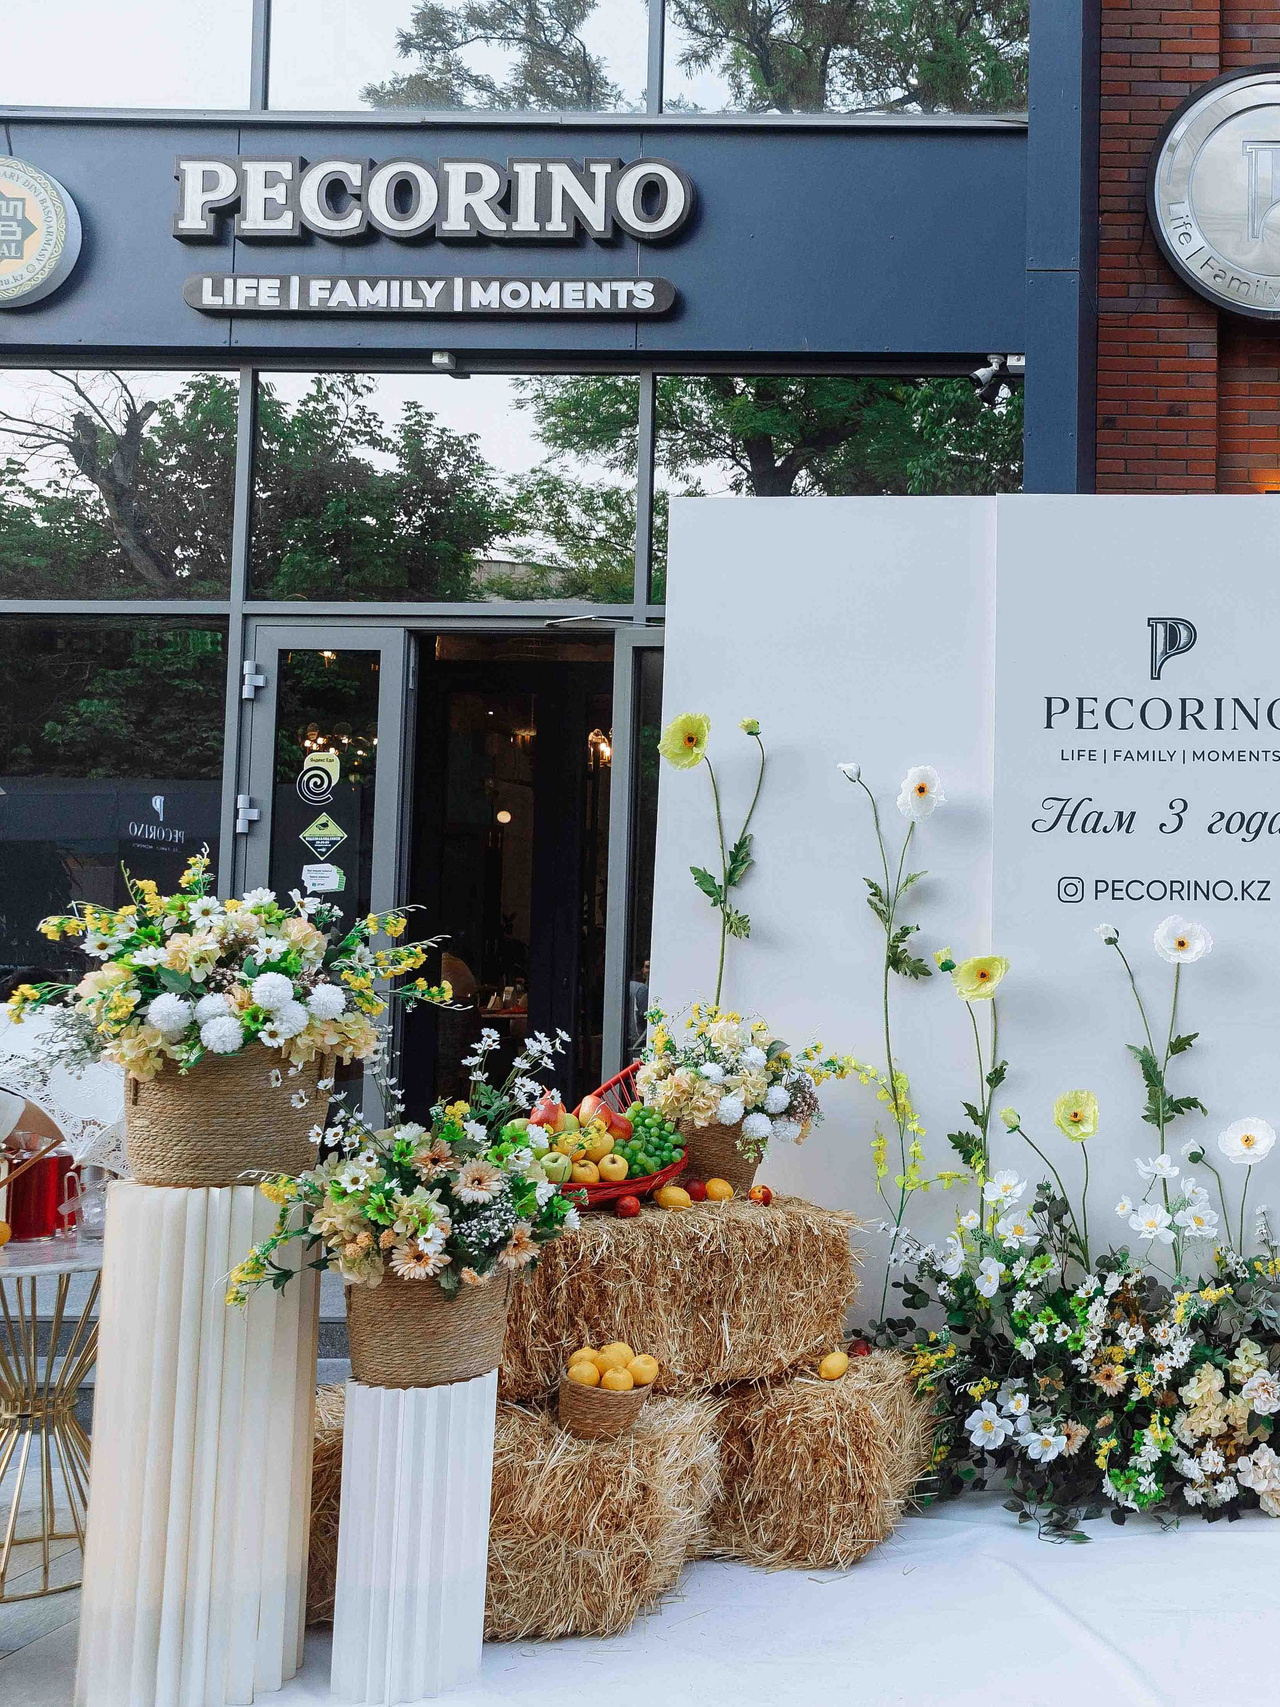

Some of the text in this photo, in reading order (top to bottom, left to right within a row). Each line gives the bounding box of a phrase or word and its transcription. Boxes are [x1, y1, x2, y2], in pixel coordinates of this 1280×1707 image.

[0, 170, 20, 183] ARY
[178, 160, 686, 234] PECORINO
[1166, 201, 1193, 246] Life
[201, 278, 655, 309] LIFE FAMILY MOMENTS
[1060, 749, 1097, 762] LIFE
[1113, 749, 1177, 762] FAMILY
[1031, 797, 1137, 834] Нам
[1158, 797, 1189, 834] 3
[1094, 879, 1272, 901] PECORINO.KZ
